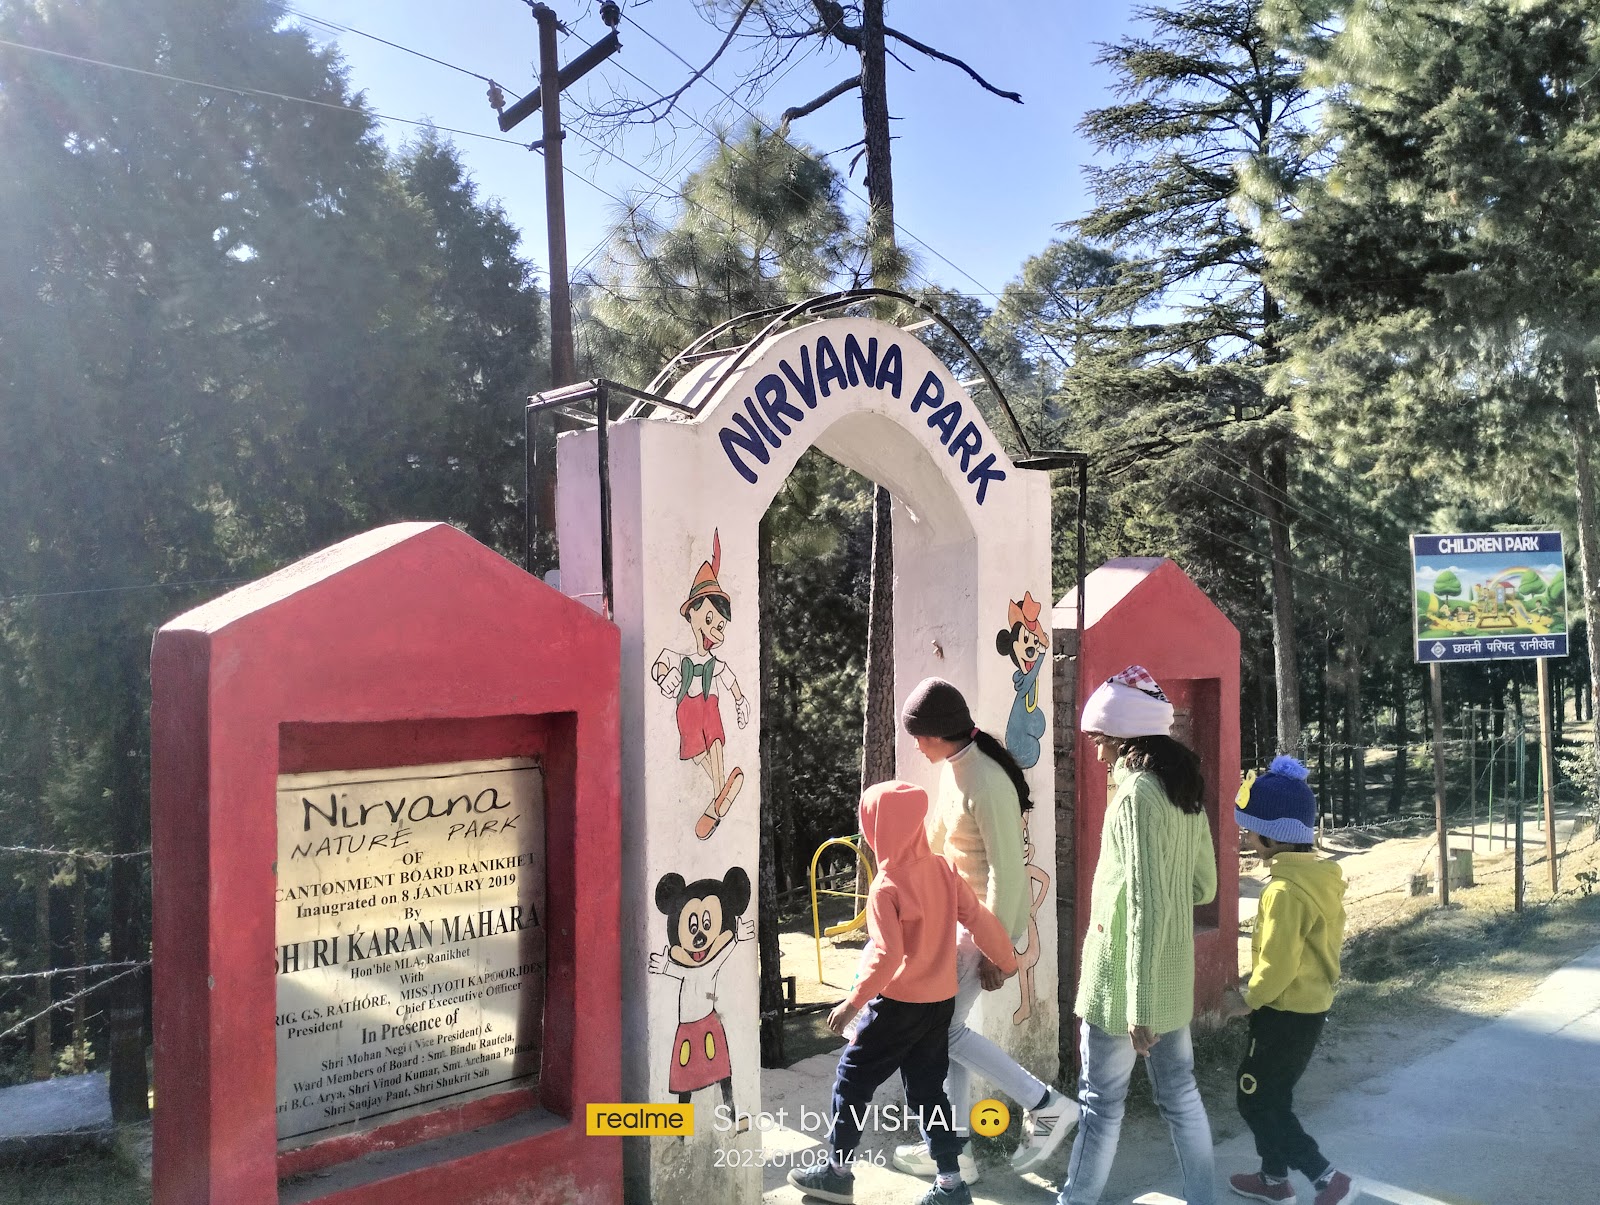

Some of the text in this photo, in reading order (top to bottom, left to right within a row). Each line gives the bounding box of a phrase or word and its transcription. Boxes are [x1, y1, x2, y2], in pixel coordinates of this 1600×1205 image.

[718, 333, 1007, 506] NIRVANA PARK
[1438, 536, 1540, 554] CHILDREN PARK
[1452, 636, 1556, 654] छावनी परिषद् रानीखेत
[302, 788, 511, 832] Nirvana
[291, 814, 521, 860] NATURE PARK
[402, 851, 424, 866] OF
[275, 852, 535, 903] CANTONMENT BOARD RANIKHET
[296, 873, 516, 918] Inaugrated on 8 JANUARY 2019
[346, 920, 434, 962] KARAN
[441, 902, 541, 946] MAHARA
[404, 907, 422, 921] By
[350, 962, 391, 980] Hon'ble
[426, 947, 471, 964] Ranikhet
[400, 972, 424, 986] With
[326, 994, 391, 1017] RATHORE,
[396, 1000, 426, 1016] Chief
[400, 986, 428, 1002] MISS
[430, 978, 464, 995] JYOTI
[287, 1019, 344, 1039] President
[361, 1008, 460, 1045] In Presence of
[321, 1056, 344, 1072] Shri
[346, 1050, 382, 1066] Mohan
[385, 1042, 406, 1056] Negi
[484, 1022, 493, 1033] &
[291, 1096, 314, 1110] B.C.
[317, 1091, 346, 1104] Arya,
[348, 1081, 370, 1096] Shri
[373, 1074, 402, 1090] Vinod
[404, 1066, 440, 1082] Kumar,
[464, 1051, 501, 1068] Archana
[293, 1077, 322, 1093] Ward
[326, 1067, 374, 1086] Members
[376, 1062, 388, 1074] of
[389, 1055, 418, 1071] Board
[450, 1042, 477, 1056] Bindu
[324, 1102, 346, 1118] Shri
[348, 1096, 382, 1112] Sanjay
[386, 1088, 411, 1102] Pant,
[413, 1080, 434, 1095] Shri
[436, 1071, 471, 1090] Shukrit
